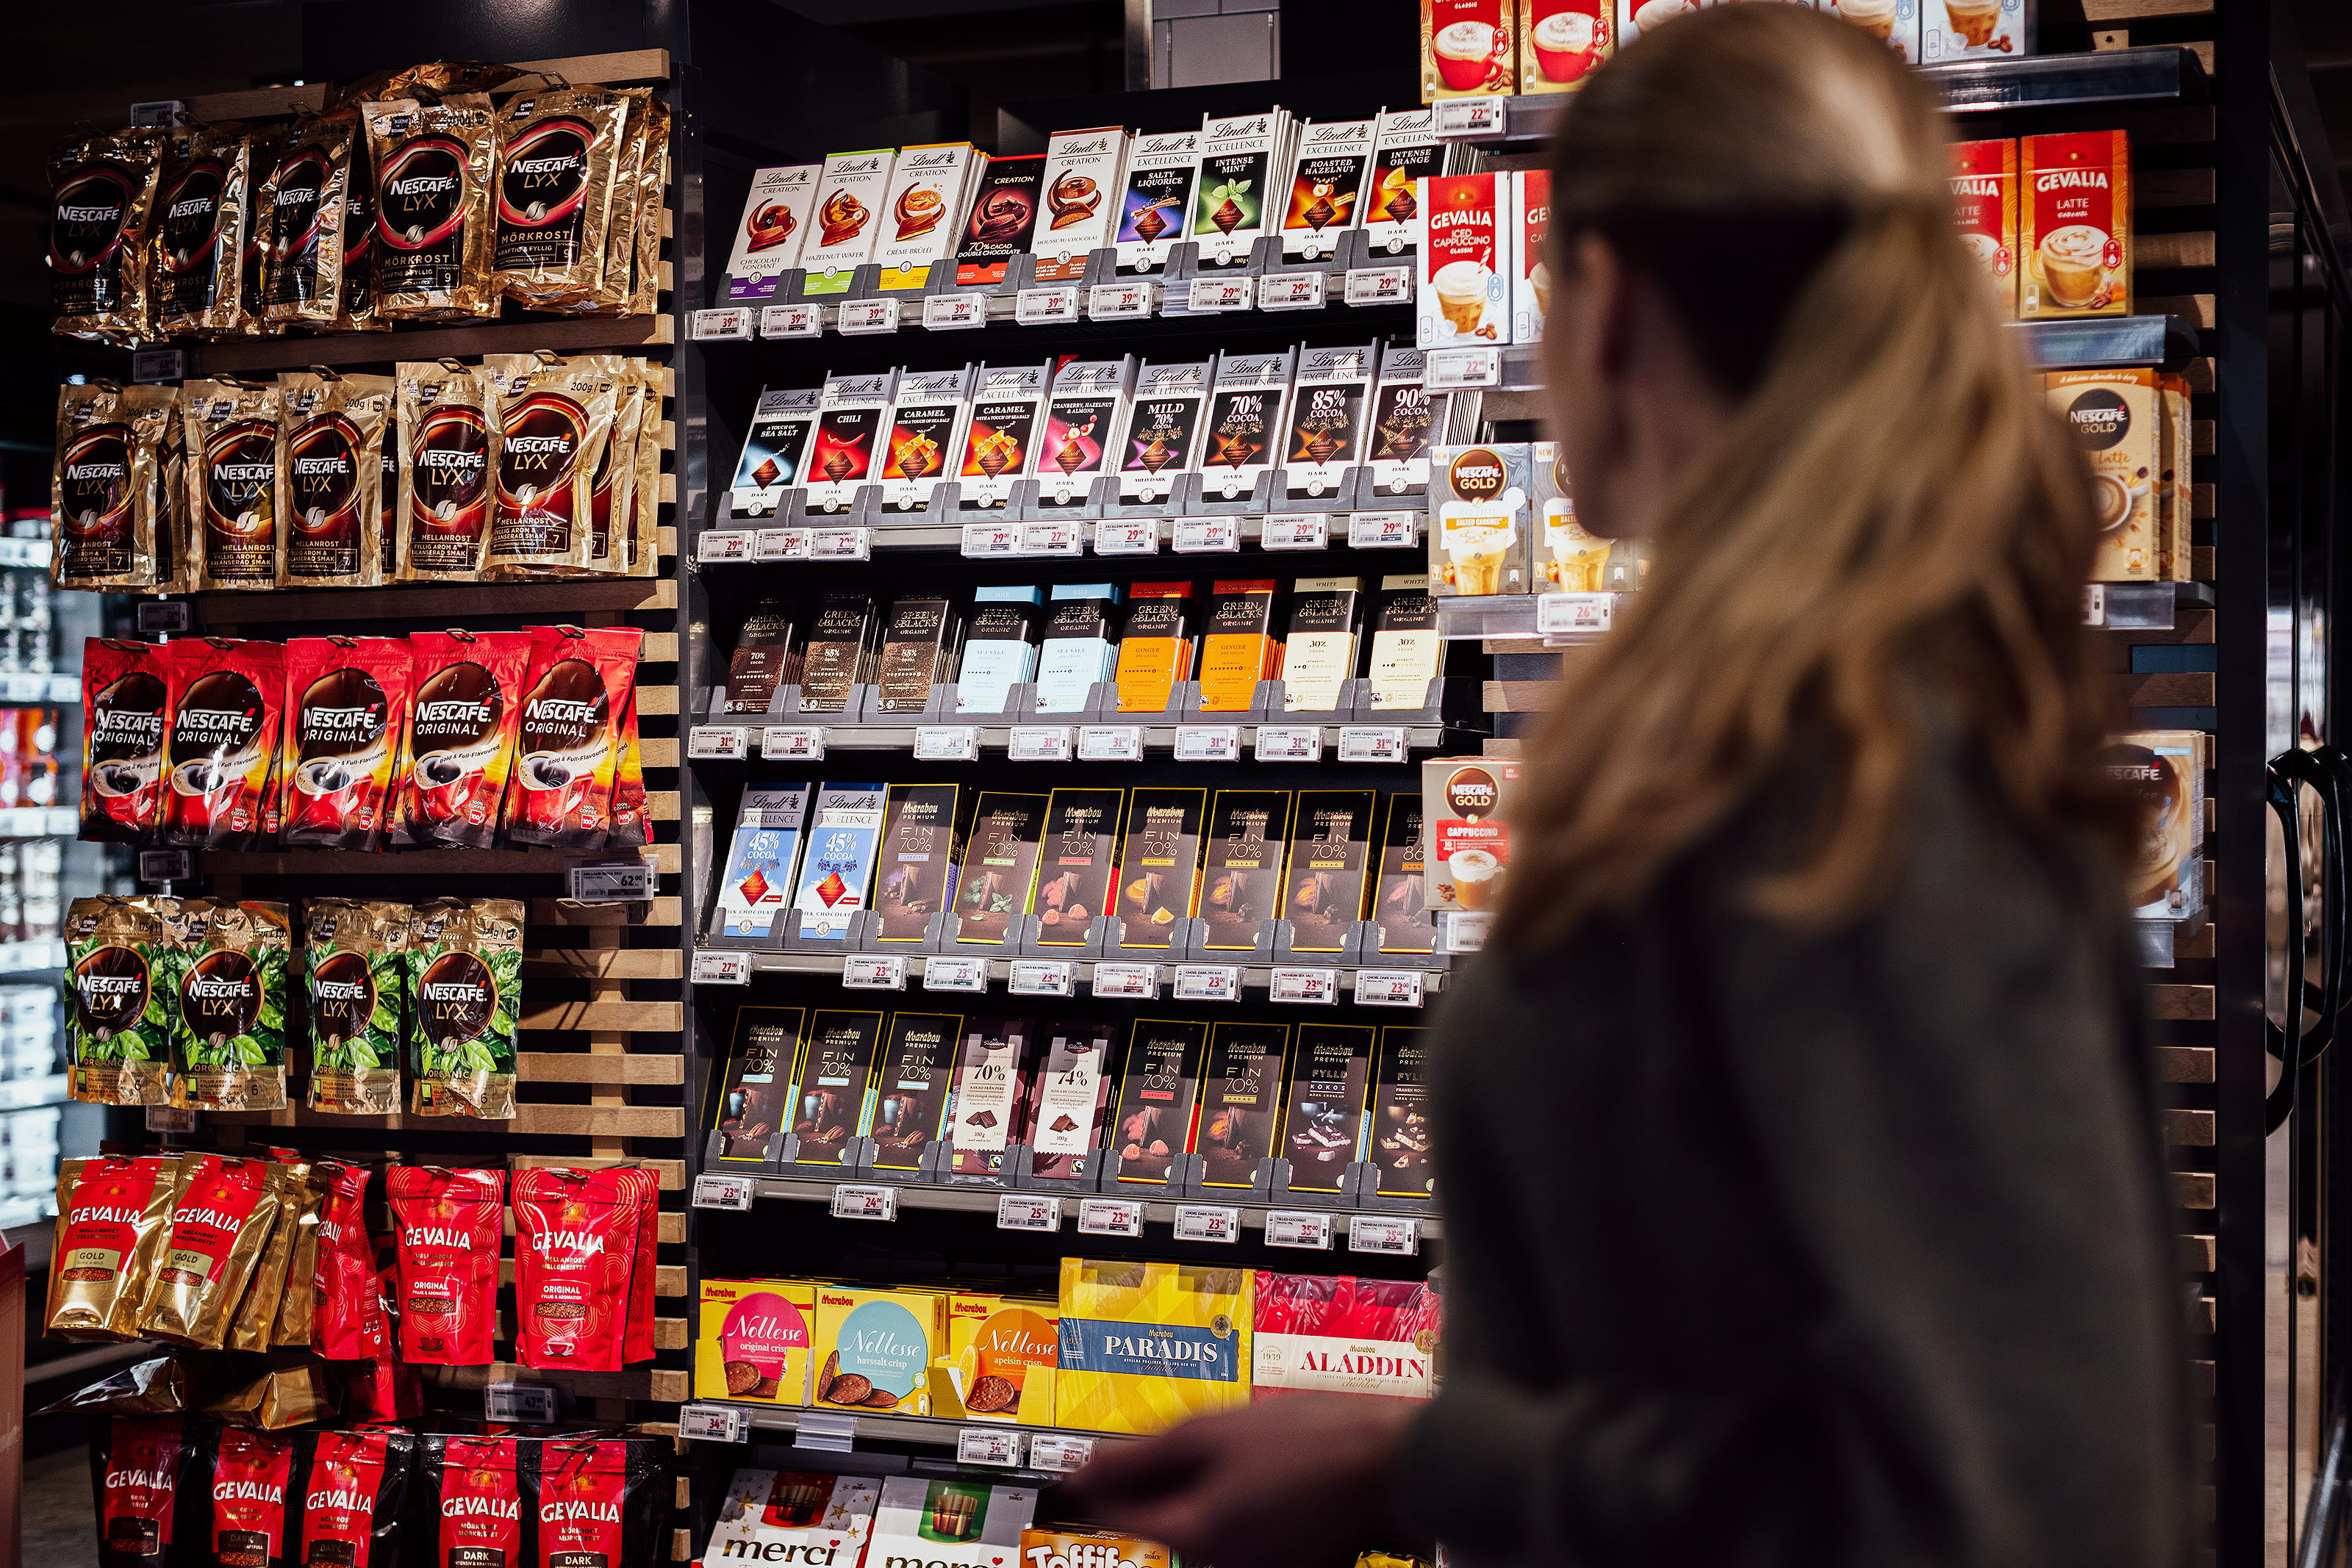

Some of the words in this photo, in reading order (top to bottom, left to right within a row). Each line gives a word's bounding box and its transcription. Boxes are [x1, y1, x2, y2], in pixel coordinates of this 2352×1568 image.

[1208, 140, 1264, 153] EXCELLENCE
[1306, 144, 1363, 154] EXCELLENCE
[1391, 149, 1431, 159] INTENSE
[833, 161, 869, 173] Lindt
[1061, 157, 1101, 166] CREATION
[1138, 156, 1192, 166] EXCELLENCE
[1215, 157, 1254, 167] INTENSE
[1311, 159, 1352, 168] ROASTED
[1390, 157, 1430, 166] ORANGE
[1148, 171, 1175, 179] SALTY
[1222, 165, 1245, 173] MINT
[1305, 165, 1355, 175] HAZELNUT
[524, 173, 558, 188] LYX
[763, 170, 798, 184] Lindt
[834, 176, 872, 184] CREATION
[995, 176, 1034, 184] CREATION
[1138, 177, 1183, 187] LIQUORICE
[2037, 171, 2108, 192] GEVALIA
[763, 186, 800, 194] CREATION
[404, 194, 437, 212] LYX
[2057, 198, 2089, 209] LATTE
[1431, 211, 1492, 229] GEVALIA
[502, 231, 570, 243] MÖRKROST
[1434, 236, 1491, 248] CAPPUCCINO
[385, 254, 449, 266] MÖRKROST
[1061, 358, 1072, 368] NEW
[571, 382, 592, 393] 200g
[1222, 378, 1278, 388] EXCELLENCE
[828, 398, 879, 406] EXCELLENCE
[1230, 395, 1263, 414] 70%
[1311, 389, 1346, 411] 85%
[905, 410, 945, 418] CARAMEL
[983, 406, 1025, 414] CARAMEL
[1147, 403, 1184, 414] MILD
[1310, 409, 1344, 418] COCOA
[1394, 407, 1428, 416] COCOA
[837, 415, 861, 423] CHILI
[1227, 414, 1260, 423] COCOA
[514, 454, 549, 470] LYX
[304, 476, 331, 492] LYX
[431, 470, 465, 486] LYX
[1460, 478, 1497, 489] GOLD
[825, 611, 857, 619] GREEN
[1139, 605, 1172, 614] GREEN
[417, 723, 478, 736] ORIGINAL
[526, 721, 586, 738] ORIGINAL
[178, 731, 241, 745] ORIGINAL
[440, 755, 451, 763] Bold
[459, 745, 501, 758] Full-Flavoured
[567, 747, 609, 762] Full-Flavoured
[1455, 796, 1491, 806] GOLD
[902, 802, 938, 814] Marabou
[745, 815, 795, 824] EXCELLENCE
[749, 832, 779, 851] 45%
[825, 832, 856, 851] 45%
[900, 838, 932, 852] 70%
[747, 852, 776, 860] COCOA
[824, 852, 853, 860] COCOA
[1311, 844, 1347, 859] 70%
[202, 1000, 234, 1015] LYX
[324, 1001, 347, 1017] LYX
[436, 1003, 468, 1020] LYX
[820, 1062, 851, 1076] 70%
[973, 1065, 1005, 1081] 70%
[1058, 1070, 1087, 1086] 74%
[173, 1208, 241, 1234] GEVALIA
[406, 1227, 470, 1251] GEVALIA
[533, 1231, 605, 1254] GEVALIA
[79, 1252, 104, 1260] GOLD
[175, 1254, 198, 1263] GOLD
[414, 1281, 448, 1290] ORIGINAL
[543, 1285, 580, 1294] ORIGINAL
[727, 1315, 802, 1342] Noblesse
[845, 1331, 921, 1357] Noblesse
[979, 1330, 1056, 1356] Noblesse
[1104, 1336, 1217, 1362] PARADIS
[1300, 1351, 1426, 1378] ALADDIN
[213, 1481, 282, 1505] GEVALIA
[306, 1490, 372, 1514] GEVALIA
[442, 1496, 520, 1521] GEVALIA
[541, 1500, 620, 1523] GEVALIA
[230, 1533, 254, 1543] DARK
[464, 1551, 489, 1561] DARK
[723, 1539, 836, 1561] merci
[565, 1556, 592, 1564] DARK
